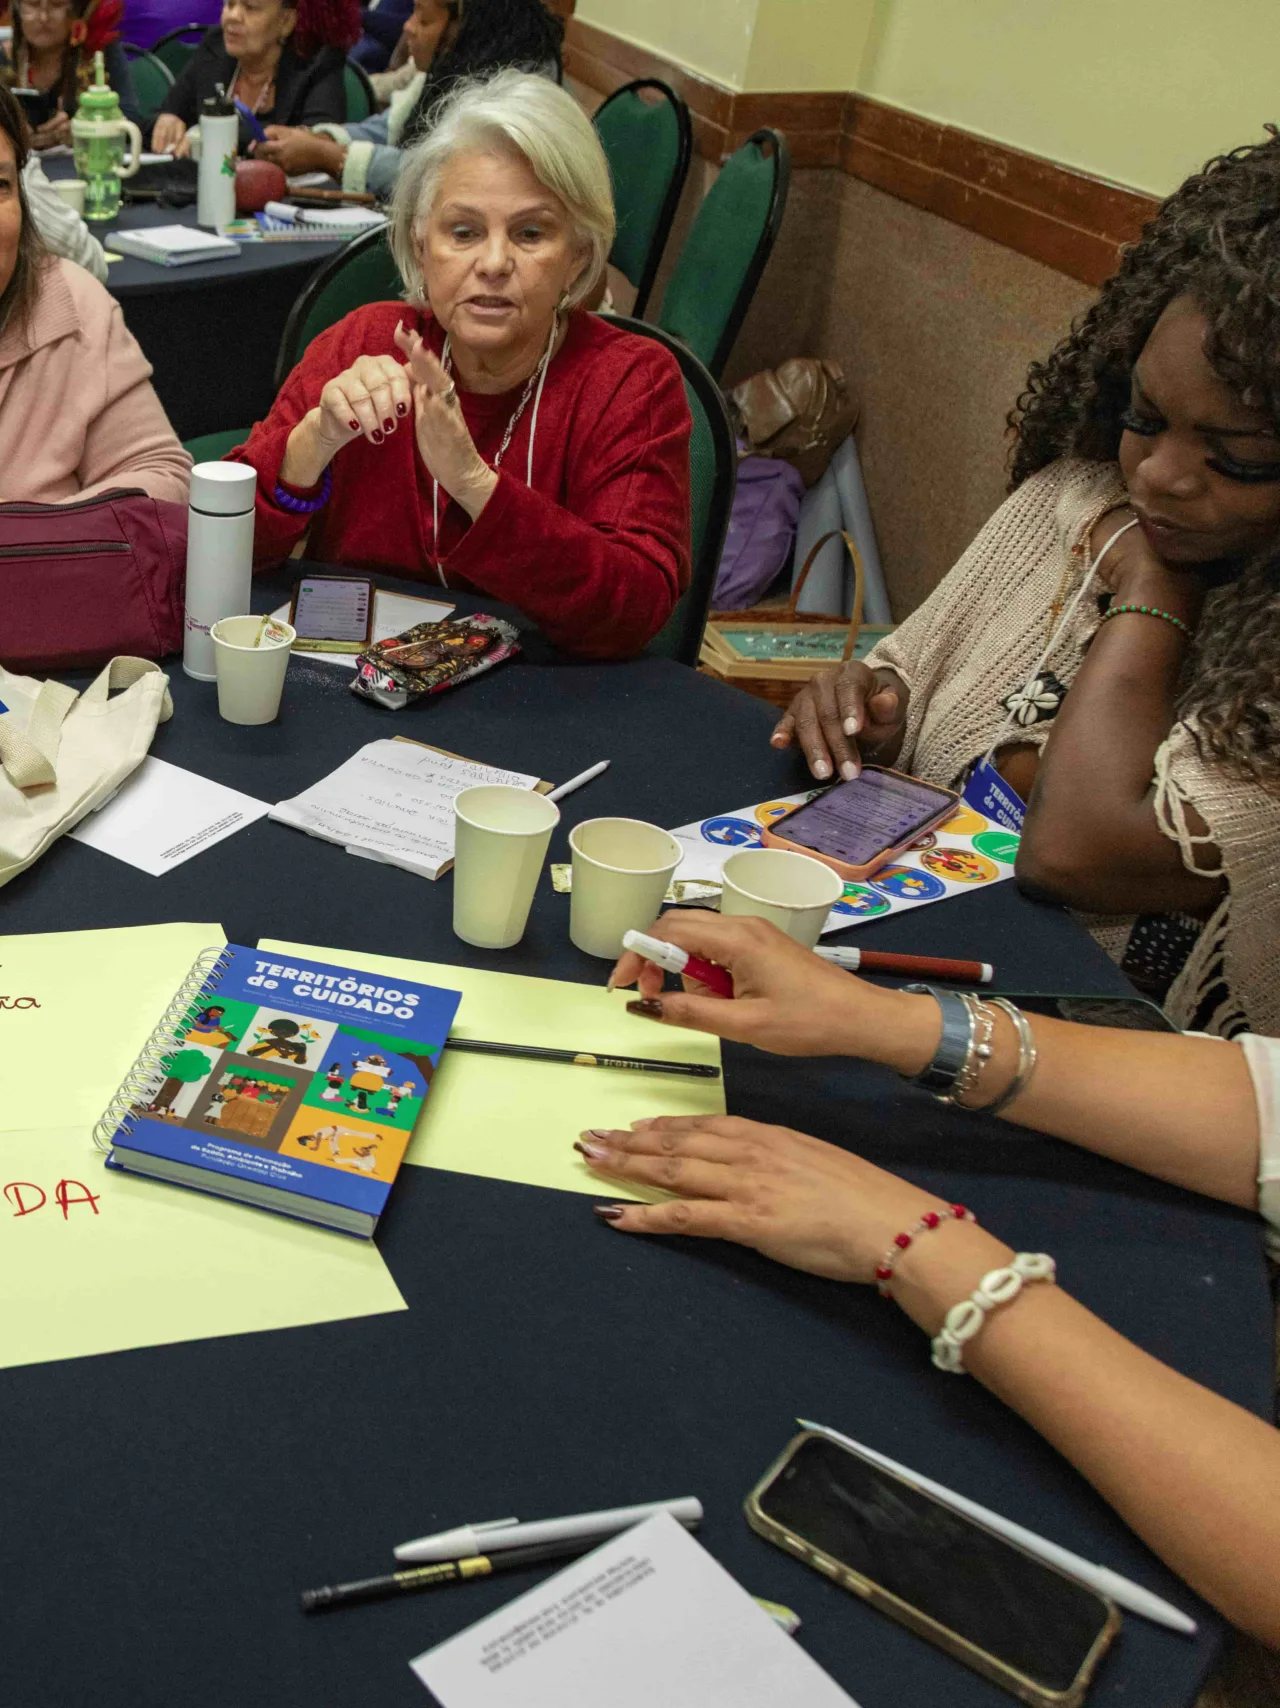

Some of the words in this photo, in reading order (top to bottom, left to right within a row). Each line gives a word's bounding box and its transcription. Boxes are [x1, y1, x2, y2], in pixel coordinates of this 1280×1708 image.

[984, 795, 995, 810] de
[997, 809, 1021, 835] CUID
[246, 974, 279, 990] de
[292, 984, 415, 1020] CUIDADO
[255, 960, 421, 1007] TERRITÓRIOS
